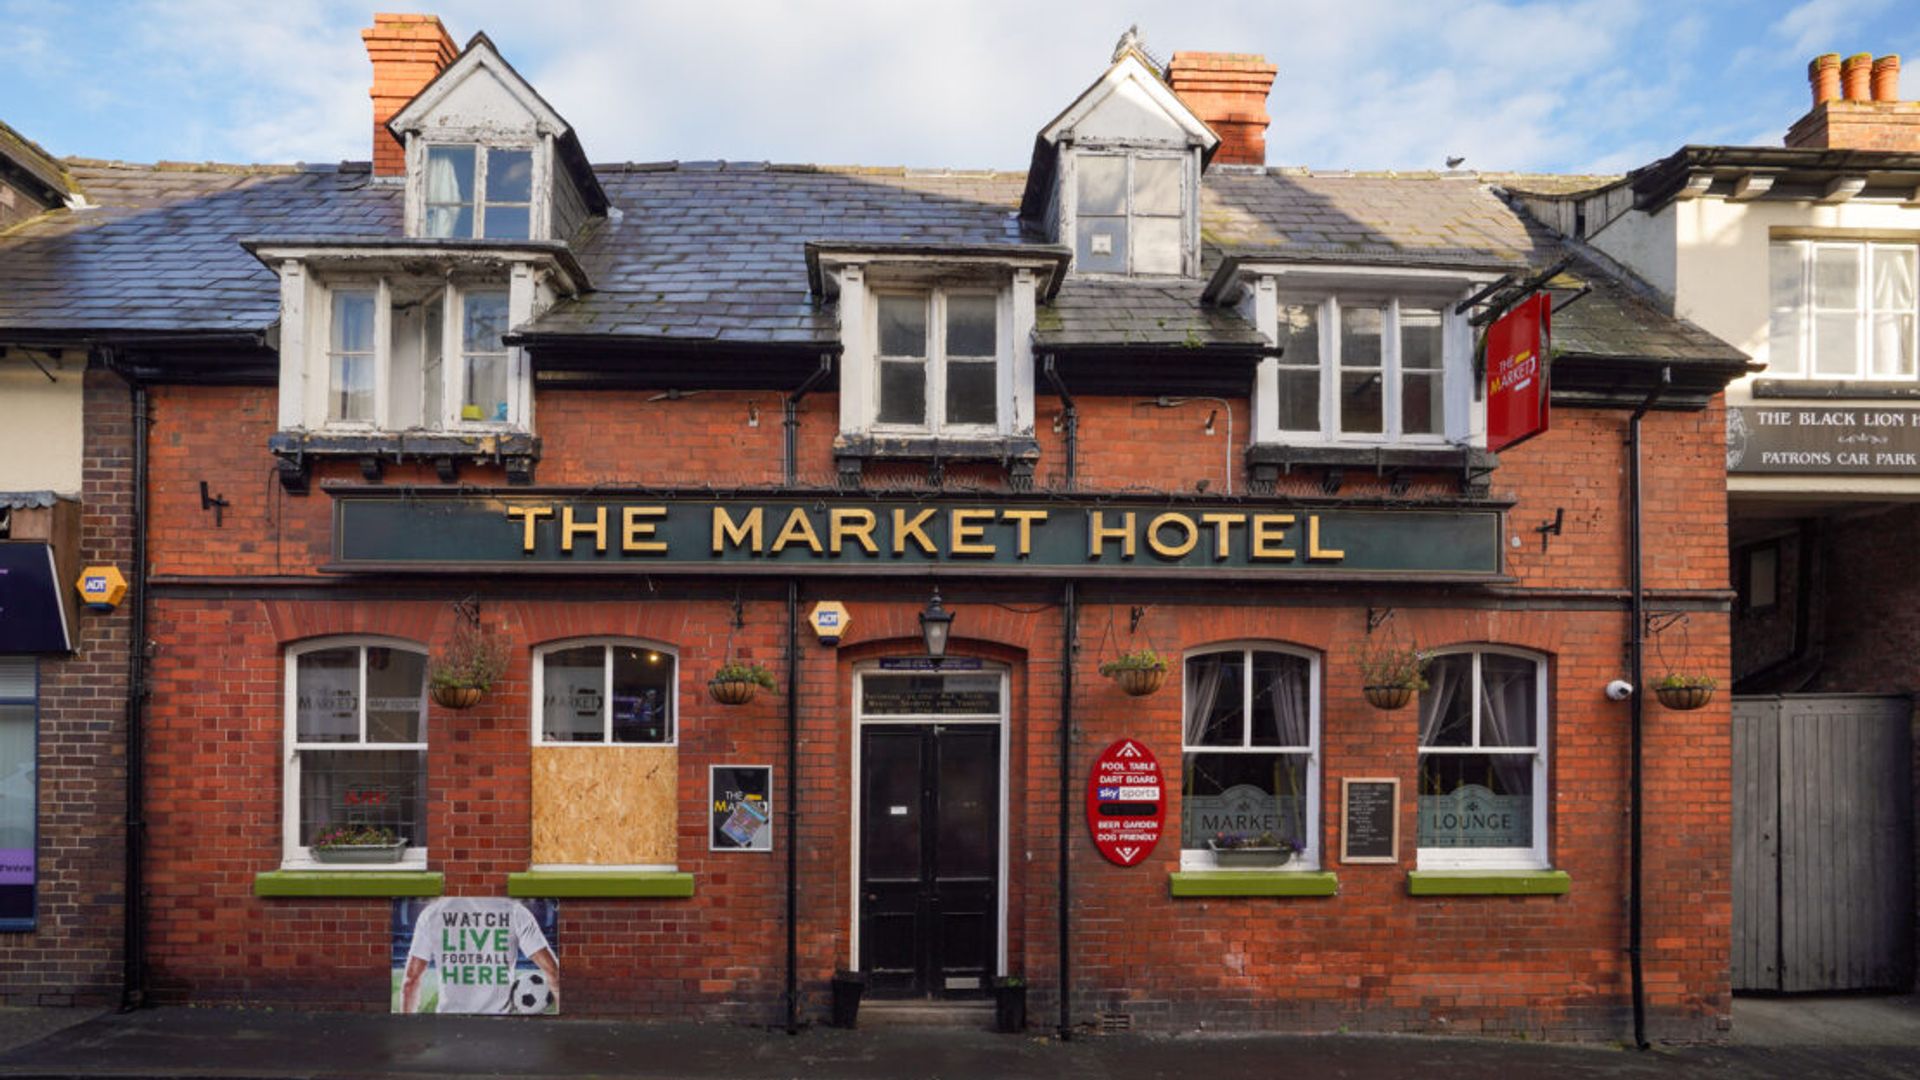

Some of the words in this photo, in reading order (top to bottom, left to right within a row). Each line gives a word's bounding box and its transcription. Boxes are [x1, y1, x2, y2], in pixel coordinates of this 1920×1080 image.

[1499, 353, 1516, 375] THE
[1490, 356, 1531, 395] MARKET
[1757, 411, 1791, 425] THE
[1799, 412, 1856, 425] BLACK
[1864, 412, 1904, 427] LION
[1761, 451, 1831, 465] PATRONS
[1837, 451, 1869, 465] CAR
[1876, 451, 1917, 465] PARK
[507, 505, 669, 553] THE
[711, 507, 1049, 556] MARKET
[1088, 511, 1346, 562] HOTEL
[86, 579, 106, 590] ADT
[819, 614, 837, 623] ADT
[1101, 762, 1125, 771] POOL
[1129, 762, 1156, 770] TABLE
[726, 790, 743, 800] THE
[1100, 788, 1118, 799] sky
[1122, 789, 1157, 798] sports
[1098, 821, 1120, 829] BEER
[1202, 815, 1286, 830] MARKET
[1433, 813, 1512, 829] LOUNGE
[442, 911, 510, 928] WATCH
[442, 929, 510, 952] LIVE
[442, 953, 510, 965] FOOTBALL
[442, 966, 510, 985] HERE
